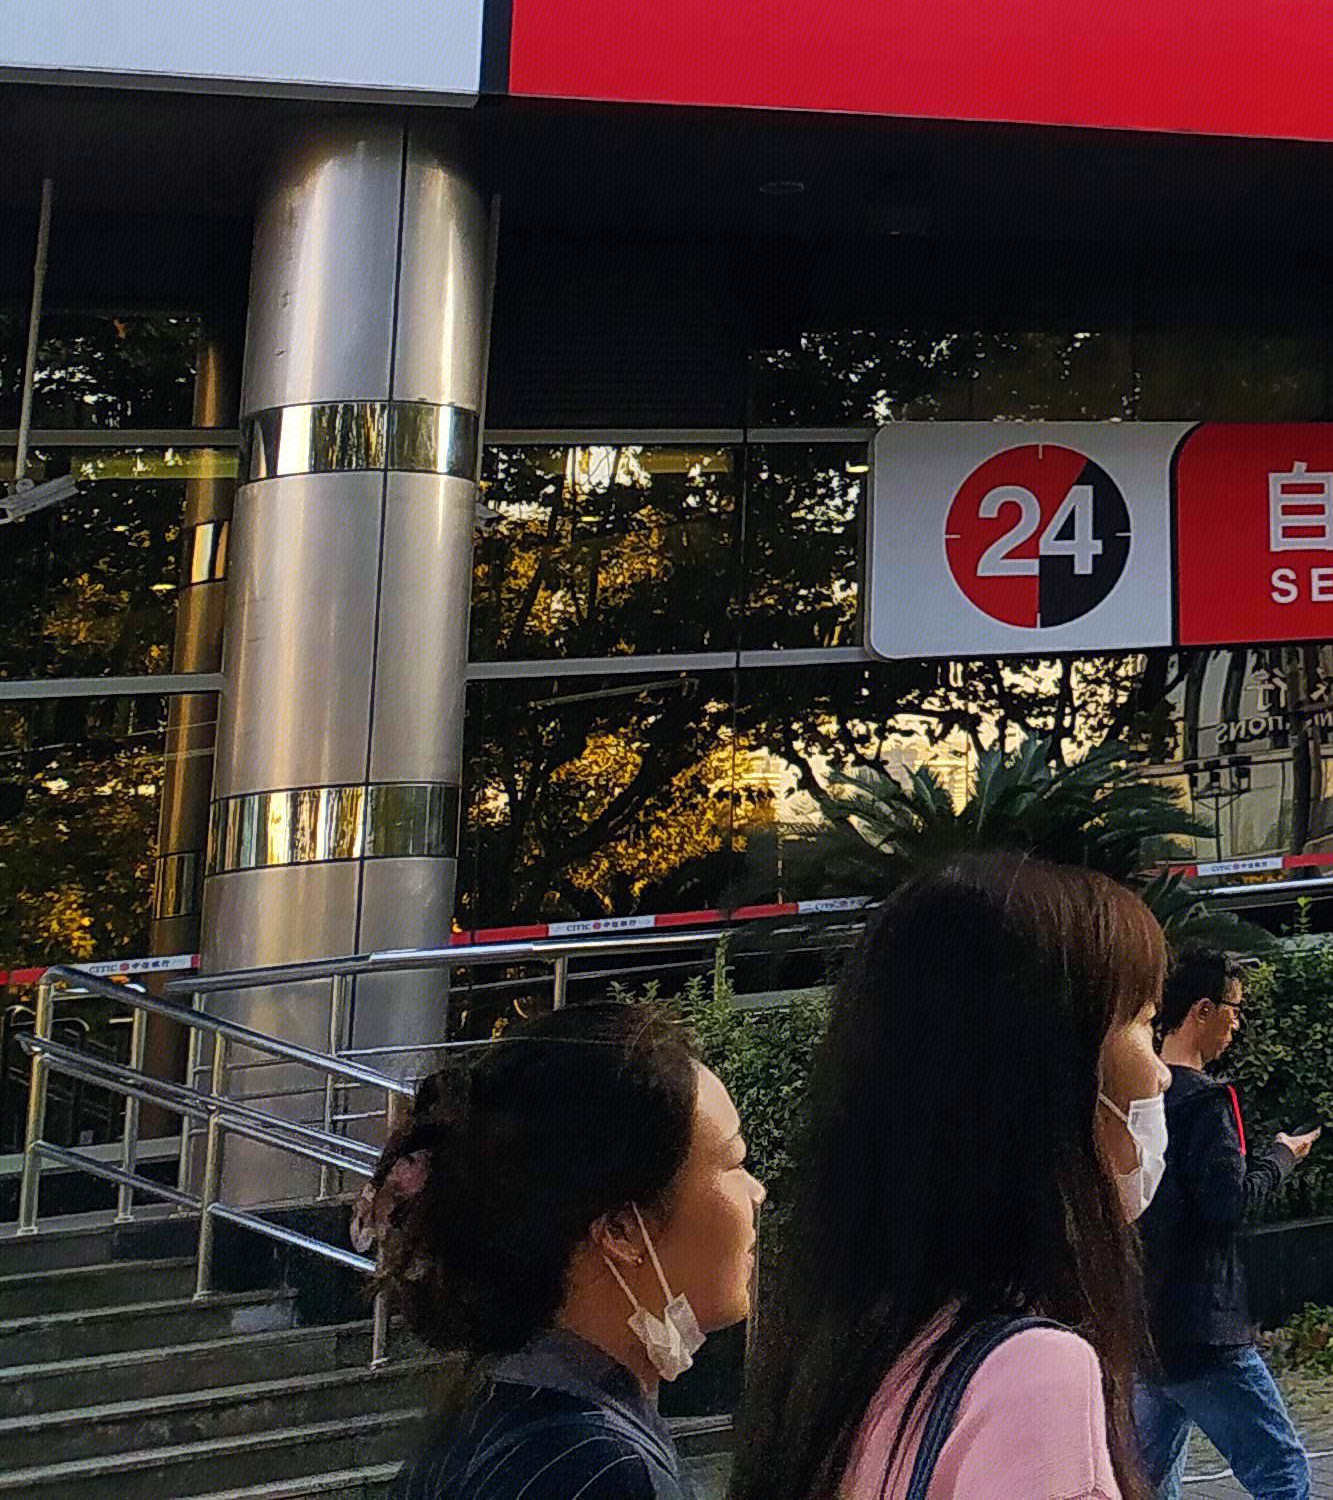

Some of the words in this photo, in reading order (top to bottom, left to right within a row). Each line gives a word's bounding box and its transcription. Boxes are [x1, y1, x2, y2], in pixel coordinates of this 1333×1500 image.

[977, 484, 1103, 577] 24
[566, 923, 591, 932] CITIC
[88, 964, 118, 974] CITIC
